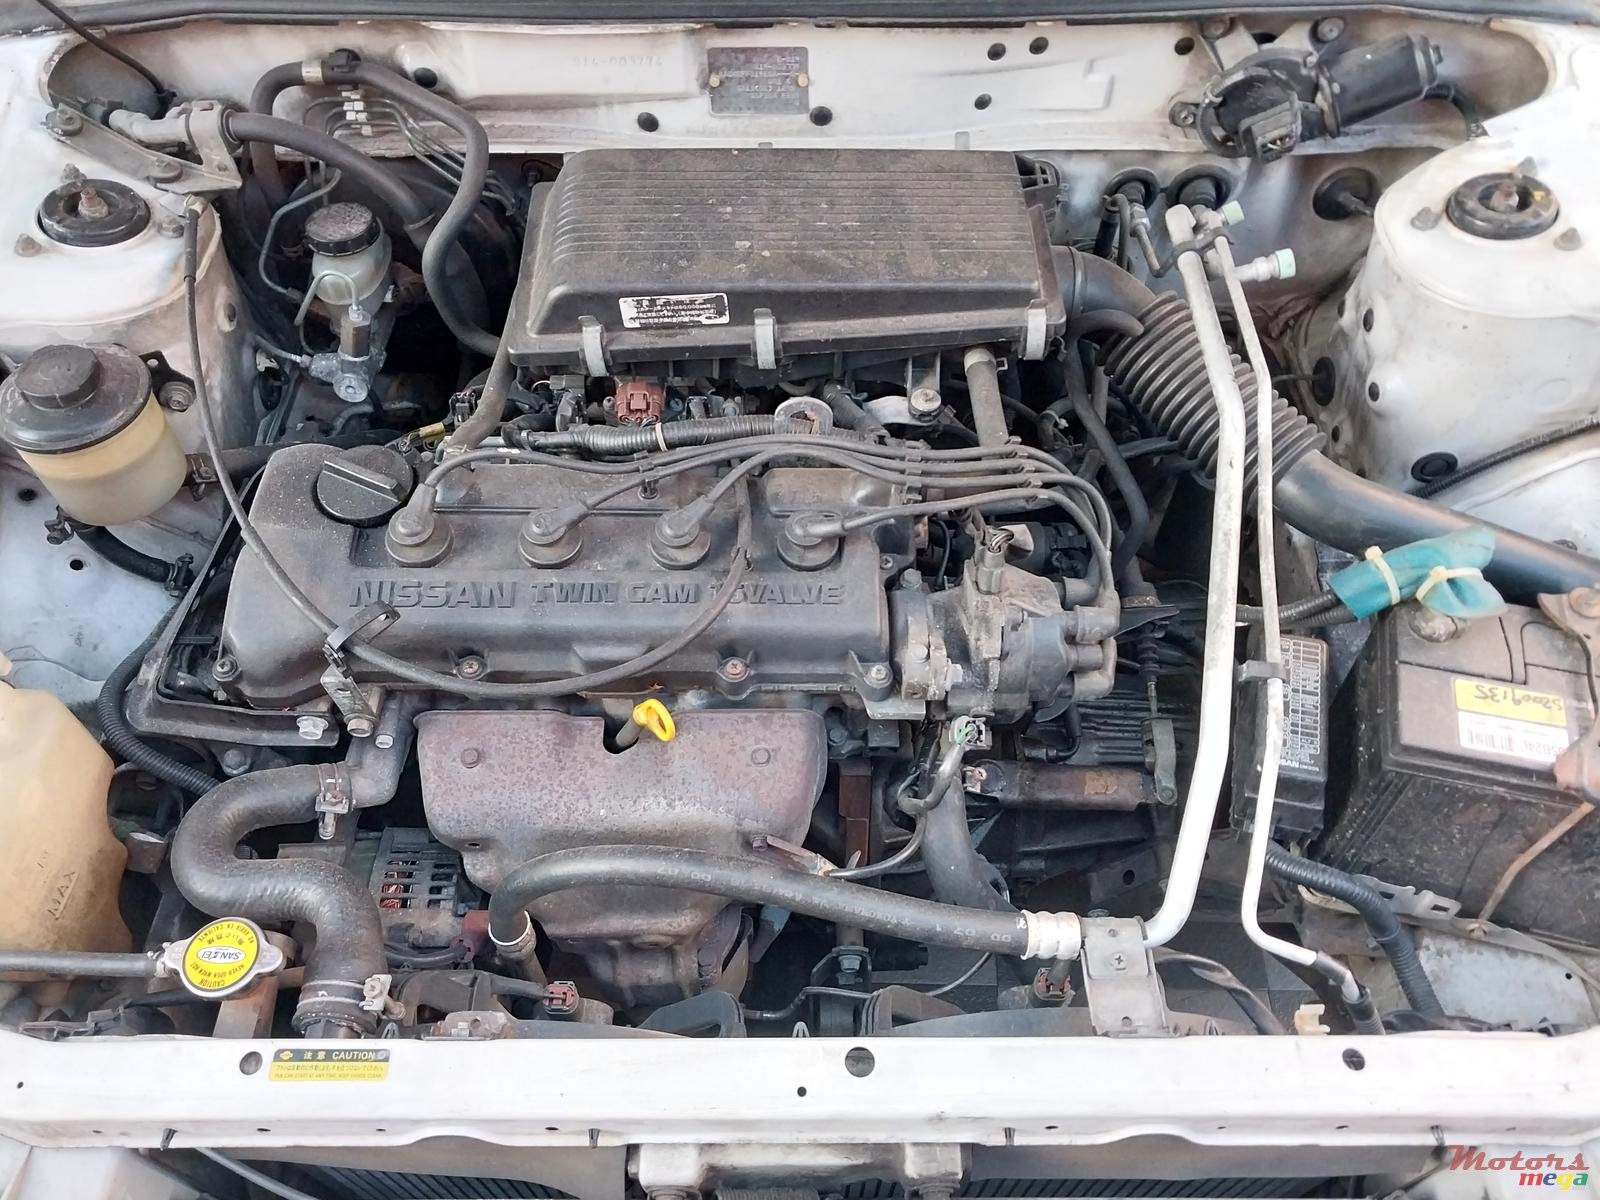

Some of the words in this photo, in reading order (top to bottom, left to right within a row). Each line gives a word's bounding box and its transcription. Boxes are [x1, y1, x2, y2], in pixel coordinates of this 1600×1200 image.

[349, 580, 517, 608] NISSAN
[531, 582, 615, 604] TWIN
[625, 582, 699, 604] CAM
[199, 978, 225, 988] CAUTION
[332, 1051, 376, 1060] CAUTION
